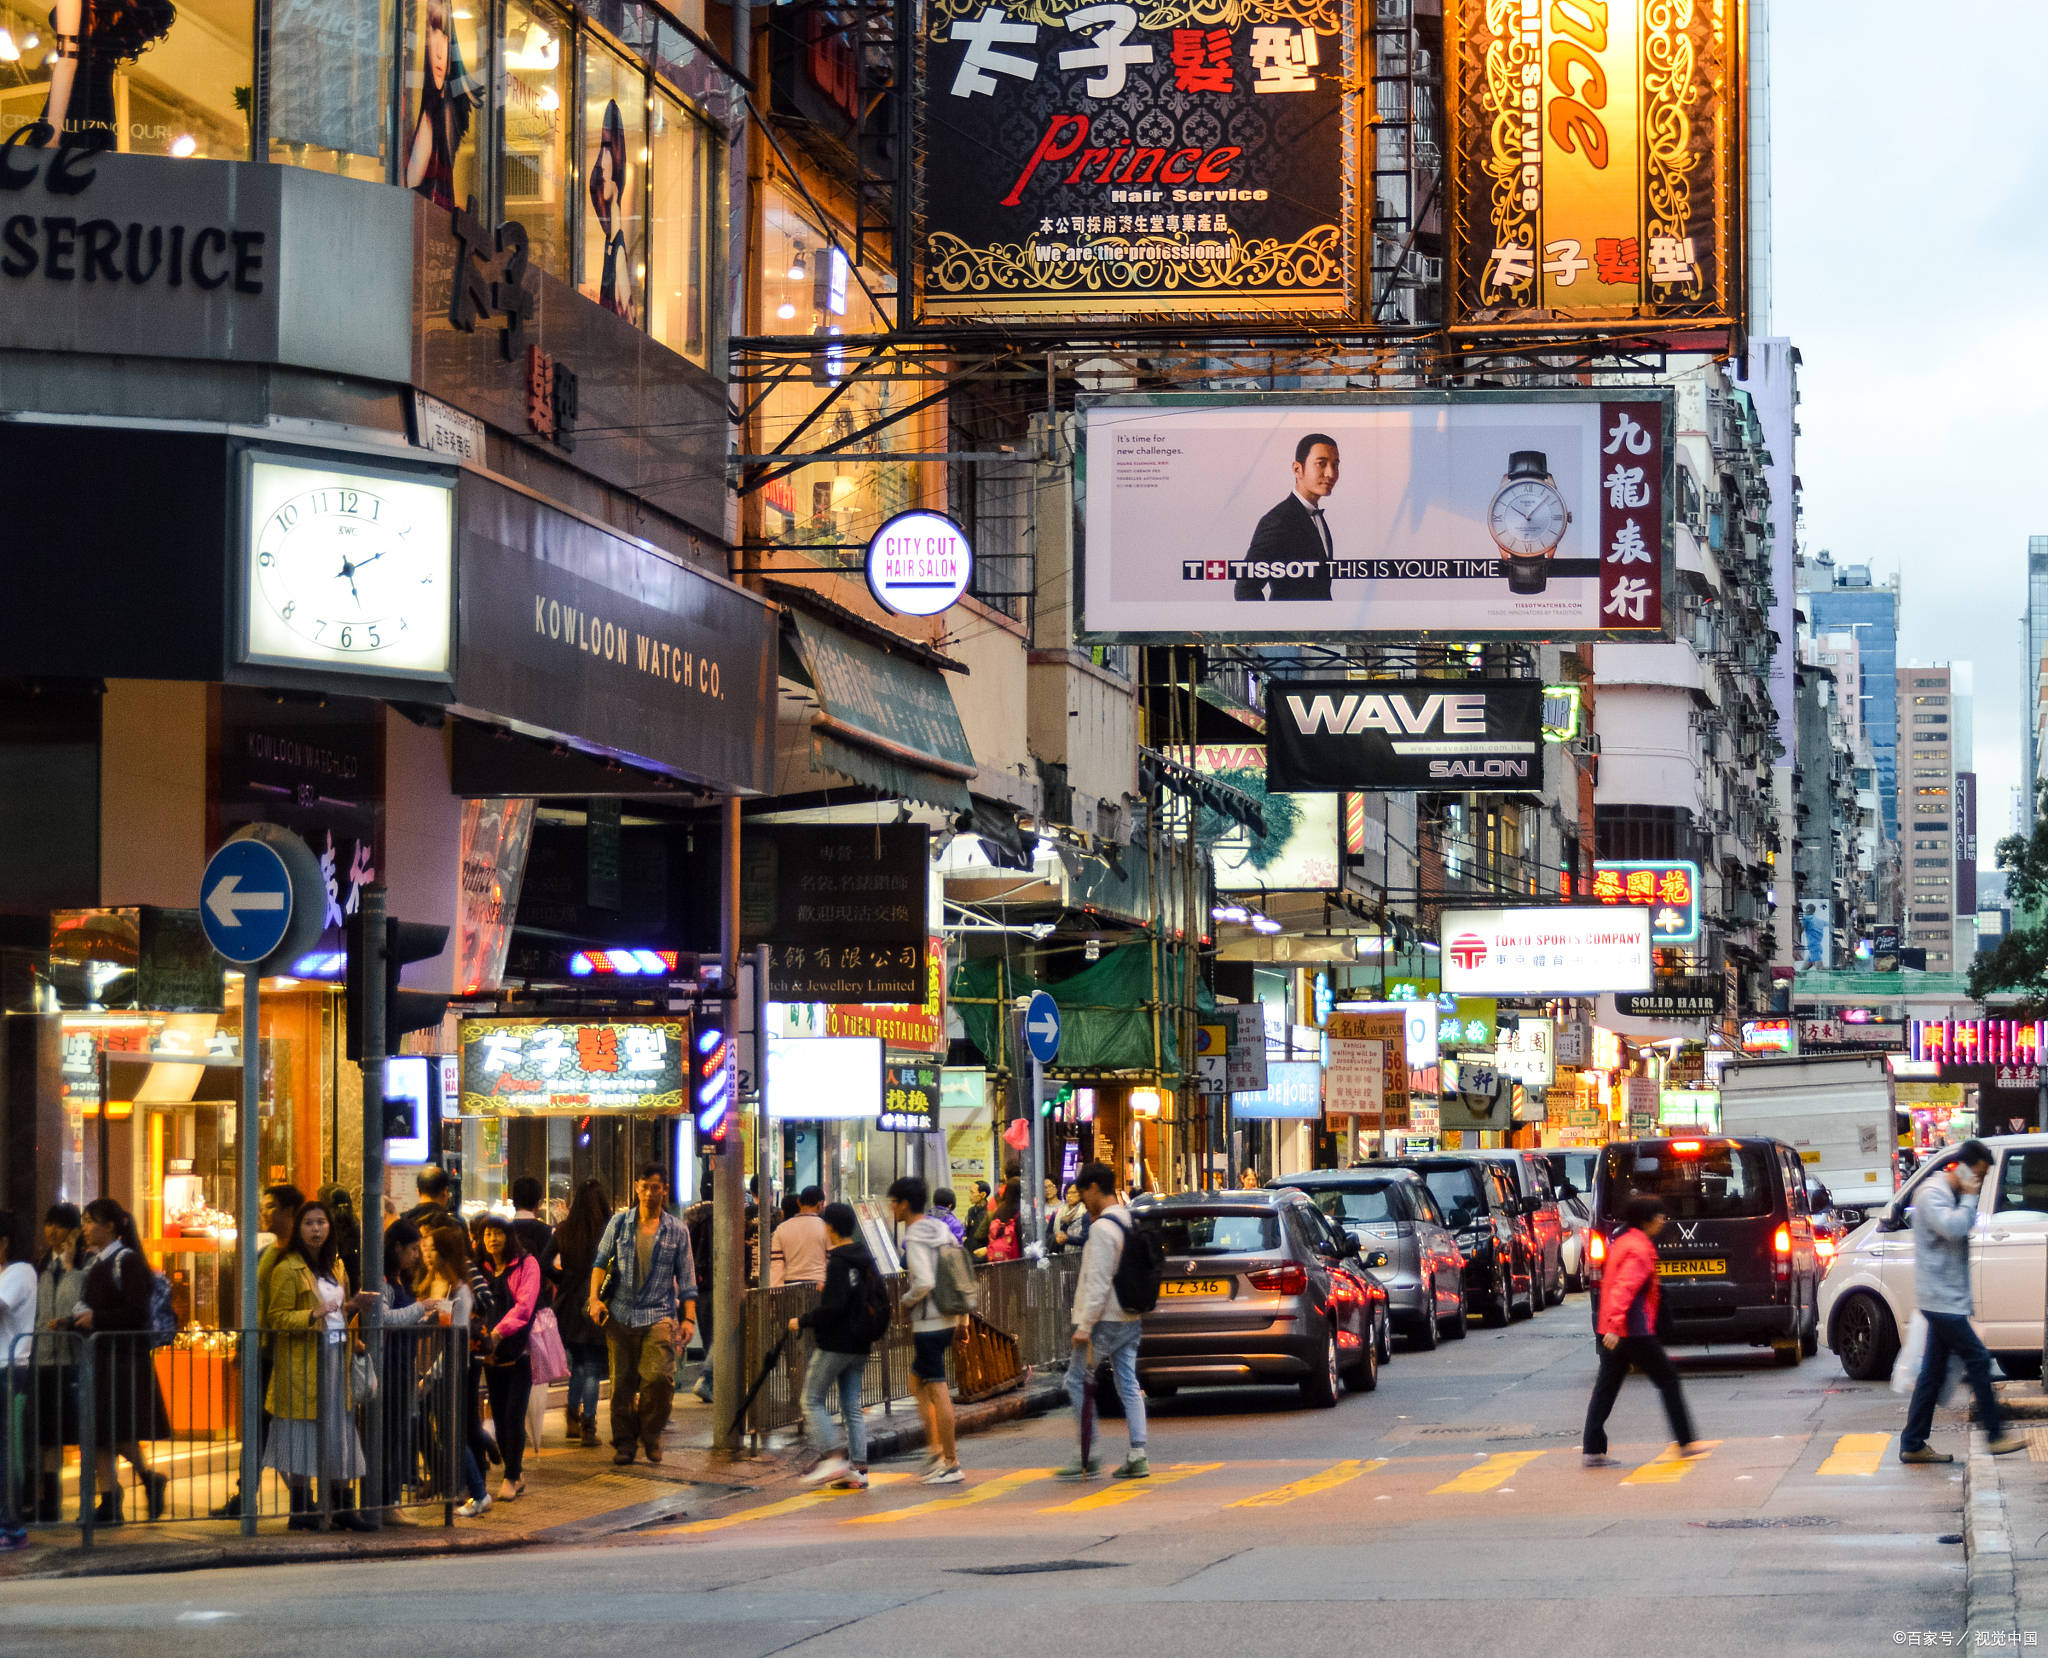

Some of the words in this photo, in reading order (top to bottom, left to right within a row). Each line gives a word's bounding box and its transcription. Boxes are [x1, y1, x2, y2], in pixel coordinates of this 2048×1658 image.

[951, 8, 1317, 98] 太子髮型
[1000, 115, 1241, 207] Prince
[1112, 190, 1163, 203] Hair
[1173, 188, 1268, 202] Service
[1036, 246, 1062, 262] We
[1066, 247, 1092, 261] are
[1097, 246, 1124, 261] the
[1128, 242, 1231, 262] professional
[1491, 237, 1694, 287] 太子髮型
[1117, 434, 1130, 443] It's
[1132, 434, 1151, 443] time
[1153, 434, 1166, 442] for
[1136, 446, 1184, 457] challenges.
[338, 491, 359, 514] 12
[372, 500, 380, 520] 1
[275, 504, 299, 533] 10
[1603, 412, 1652, 621] 九龍表行
[886, 537, 921, 556] CITY
[926, 537, 957, 556] CUT
[259, 551, 275, 568] 9
[886, 559, 914, 577] HAIR
[918, 559, 957, 577] SALON
[1230, 561, 1319, 579] TISSOT
[1325, 560, 1368, 578] THIS
[1374, 560, 1389, 577] IS
[1396, 560, 1449, 577] YOUR
[1453, 560, 1500, 577] TIME
[281, 600, 296, 620] 8
[341, 626, 352, 648] 6
[368, 624, 380, 648] 5
[535, 594, 628, 665] KOWLOON
[637, 633, 693, 688] WATCH
[699, 658, 725, 701] CO.
[1286, 694, 1486, 735] WAVE
[1205, 747, 1267, 769] WA
[1429, 760, 1528, 778] SALON
[1495, 934, 1531, 947] TOKYO
[1536, 933, 1581, 946] SPORTS
[1586, 932, 1641, 945] COMPANY
[792, 980, 803, 992] &
[806, 979, 863, 994] Jewellery
[868, 978, 915, 992] Limited
[1631, 997, 1674, 1009] SOLID
[1677, 997, 1714, 1009] HAIR
[843, 1014, 872, 1036] YUEN
[876, 1019, 939, 1044] RESTAURANT
[482, 1027, 668, 1073] 太子髮型
[1206, 1058, 1216, 1071] 7
[885, 1089, 929, 1112] 找換
[1166, 1281, 1185, 1294] LZ
[1190, 1280, 1218, 1293] 346
